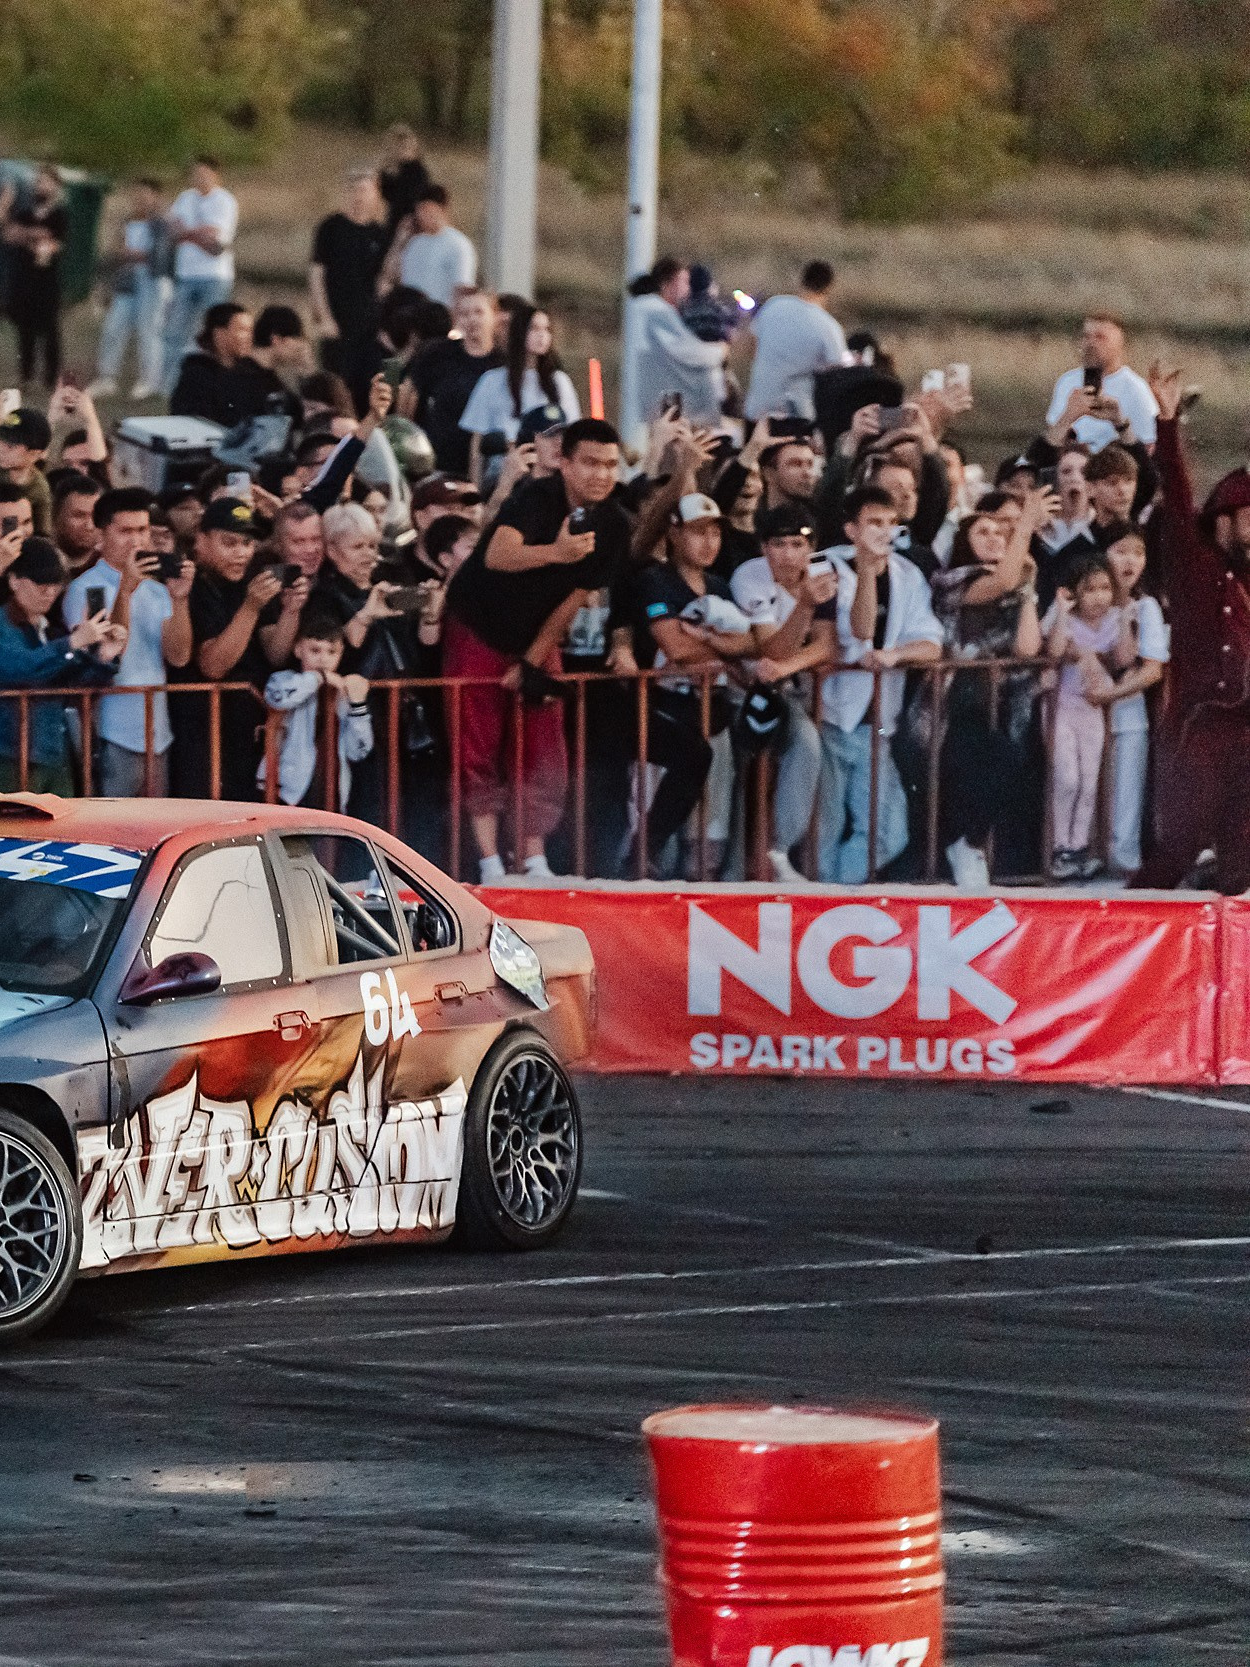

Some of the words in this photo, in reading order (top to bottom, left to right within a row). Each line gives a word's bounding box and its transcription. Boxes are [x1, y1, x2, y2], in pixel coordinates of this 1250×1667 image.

[687, 902, 1019, 1026] NGK
[360, 967, 423, 1046] 64
[689, 1033, 845, 1070] SPARK
[857, 1036, 1016, 1074] PLUGS
